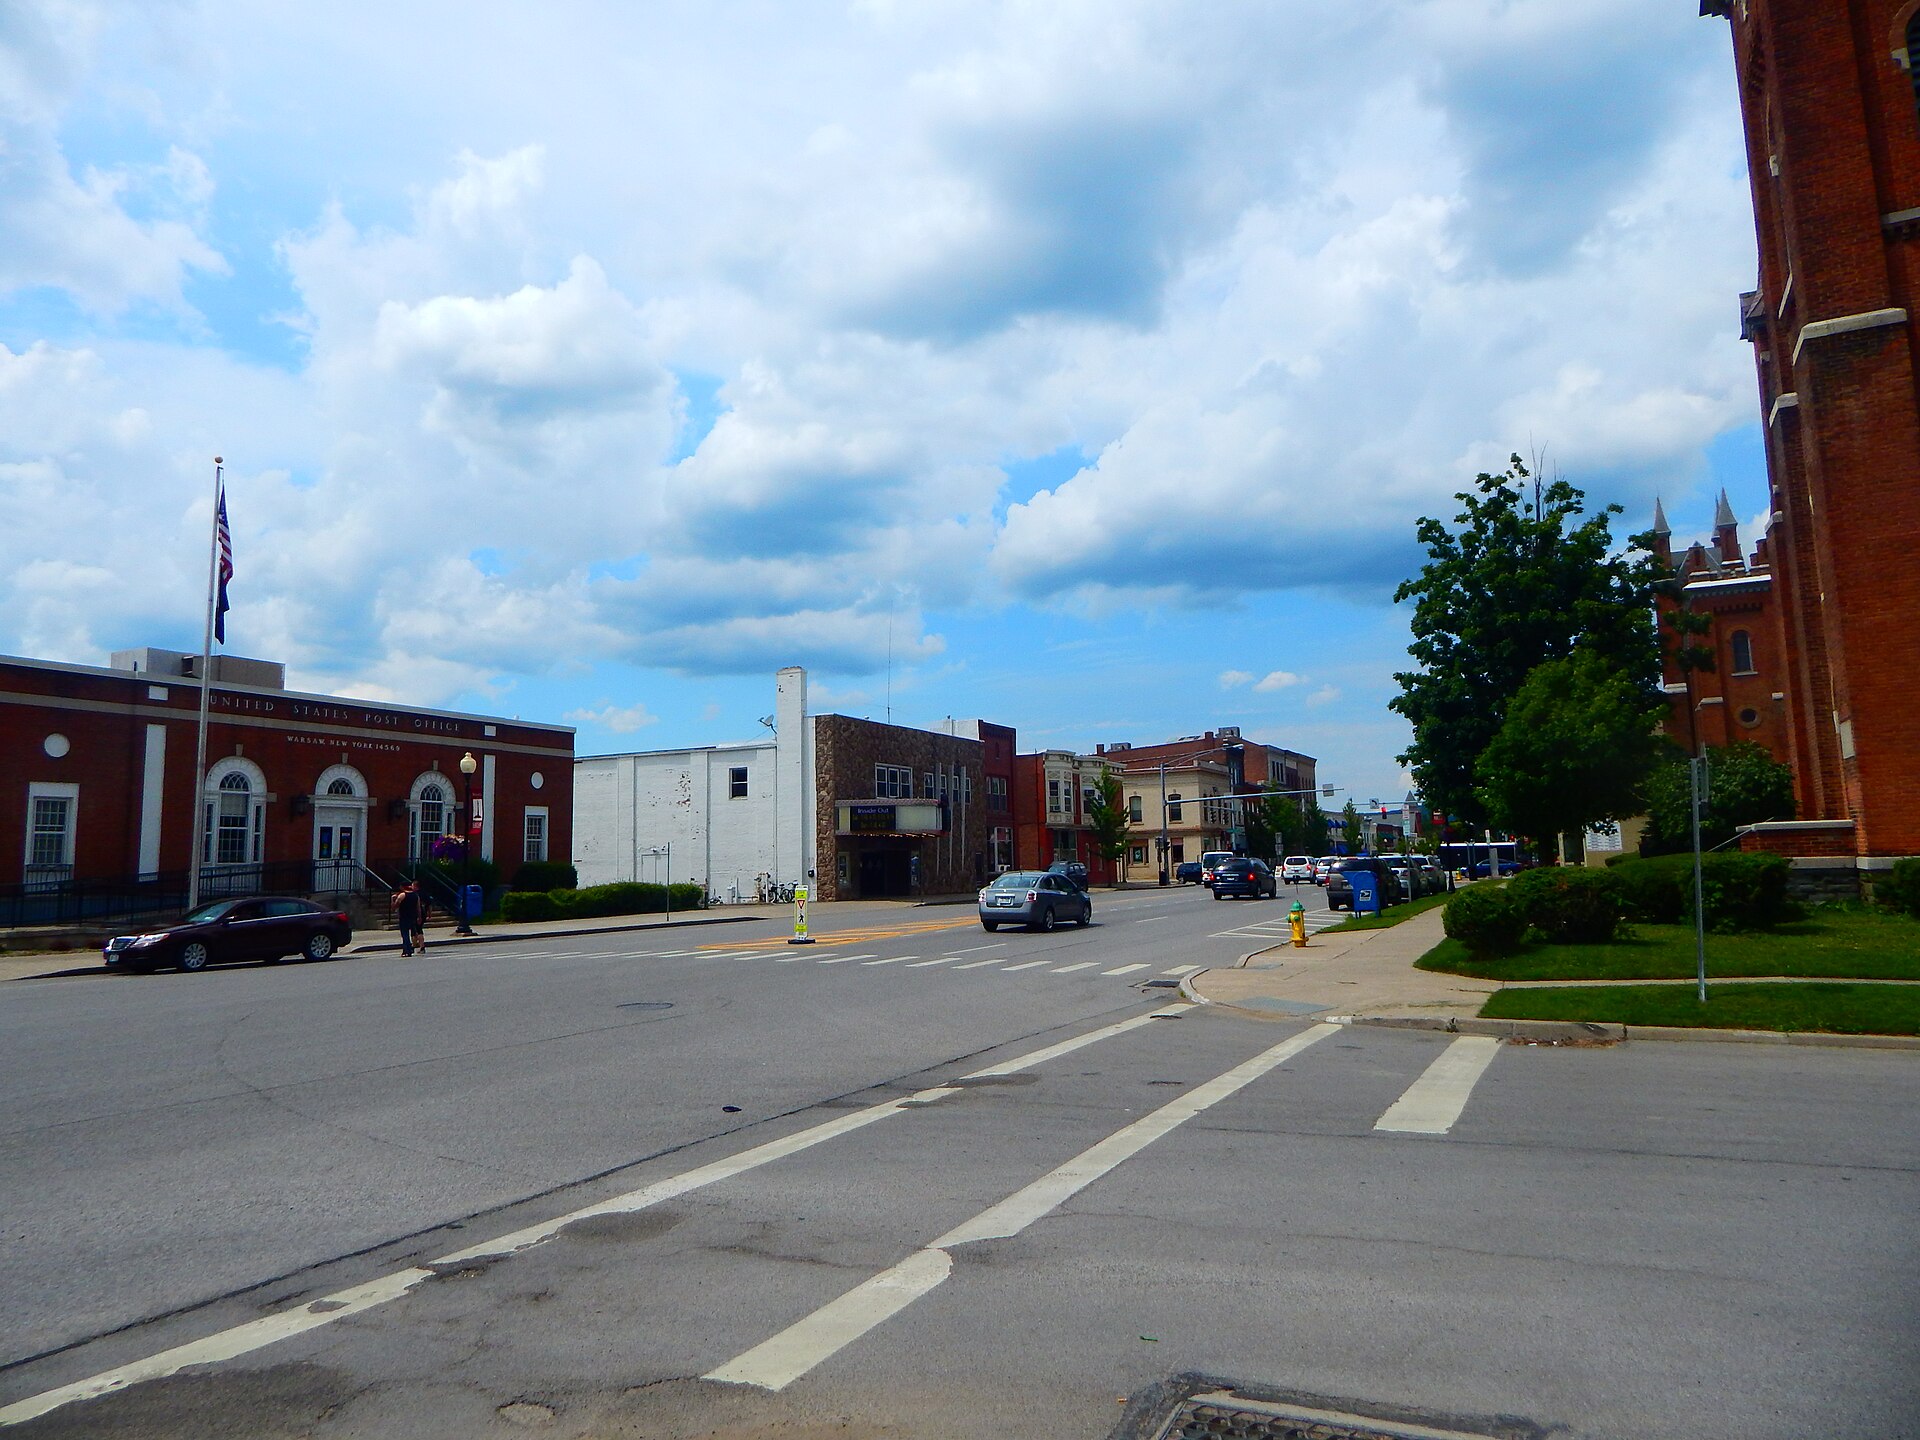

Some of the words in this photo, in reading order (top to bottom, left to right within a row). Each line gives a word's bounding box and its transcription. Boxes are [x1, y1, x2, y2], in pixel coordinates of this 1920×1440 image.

[210, 695, 274, 711] UNITED
[293, 704, 348, 719] STATES
[365, 713, 398, 725] POST
[414, 718, 460, 731] OFFICE
[329, 739, 348, 747] NEW
[352, 741, 373, 749] YORK
[375, 743, 401, 752] 14569
